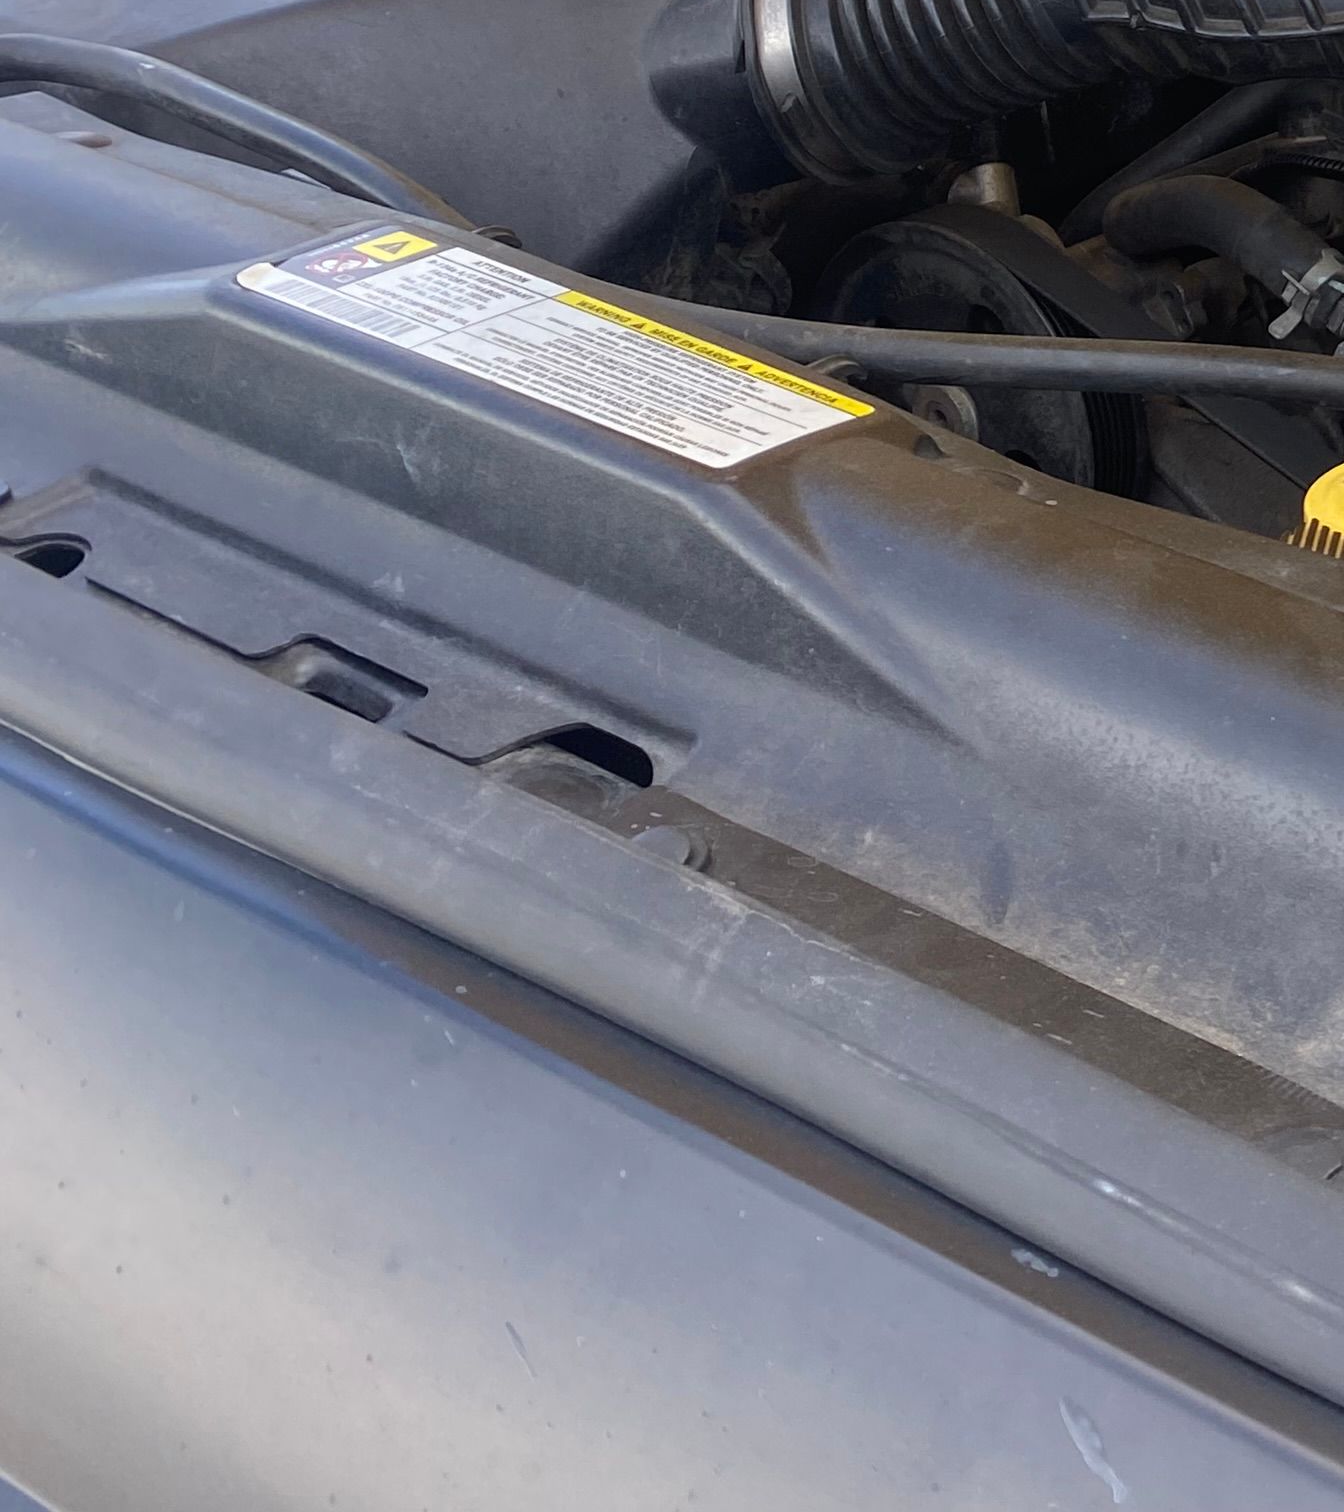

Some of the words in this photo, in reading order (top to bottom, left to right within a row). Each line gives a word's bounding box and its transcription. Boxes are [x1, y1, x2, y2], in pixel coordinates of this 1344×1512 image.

[469, 259, 534, 283] ATTENTION
[471, 275, 538, 301] REFRIGERANT
[573, 299, 633, 323] WARNING
[645, 327, 683, 342] MISE
[691, 345, 739, 364] GARDE
[752, 368, 841, 404] ADVERTENCIA
